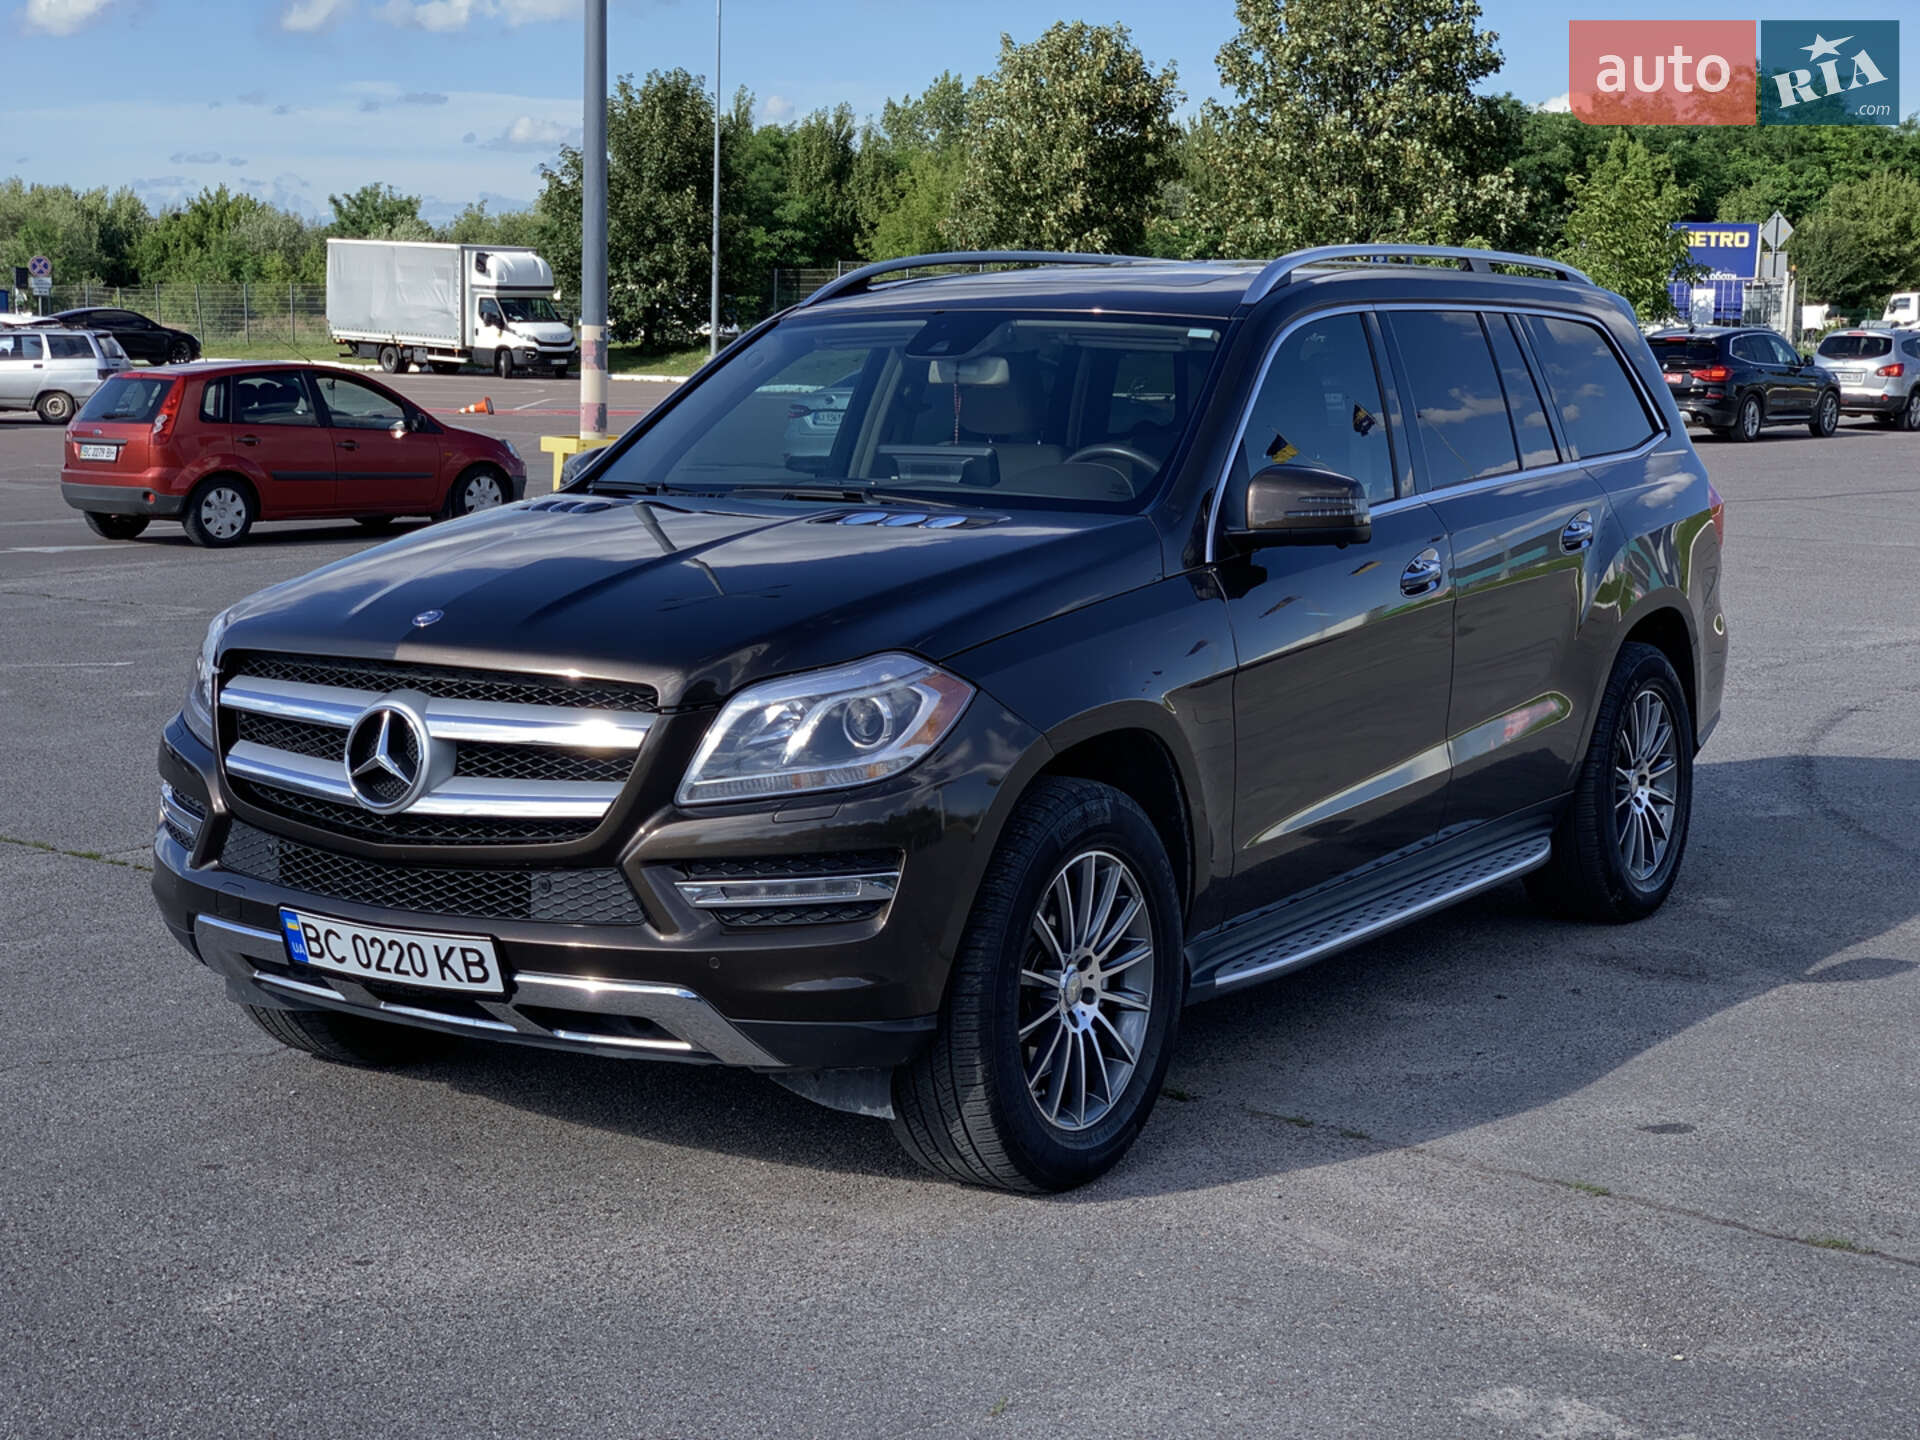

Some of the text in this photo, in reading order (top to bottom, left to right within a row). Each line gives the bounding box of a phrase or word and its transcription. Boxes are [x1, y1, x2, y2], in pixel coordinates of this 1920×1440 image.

[301, 922, 490, 984] BC 0220 KB
